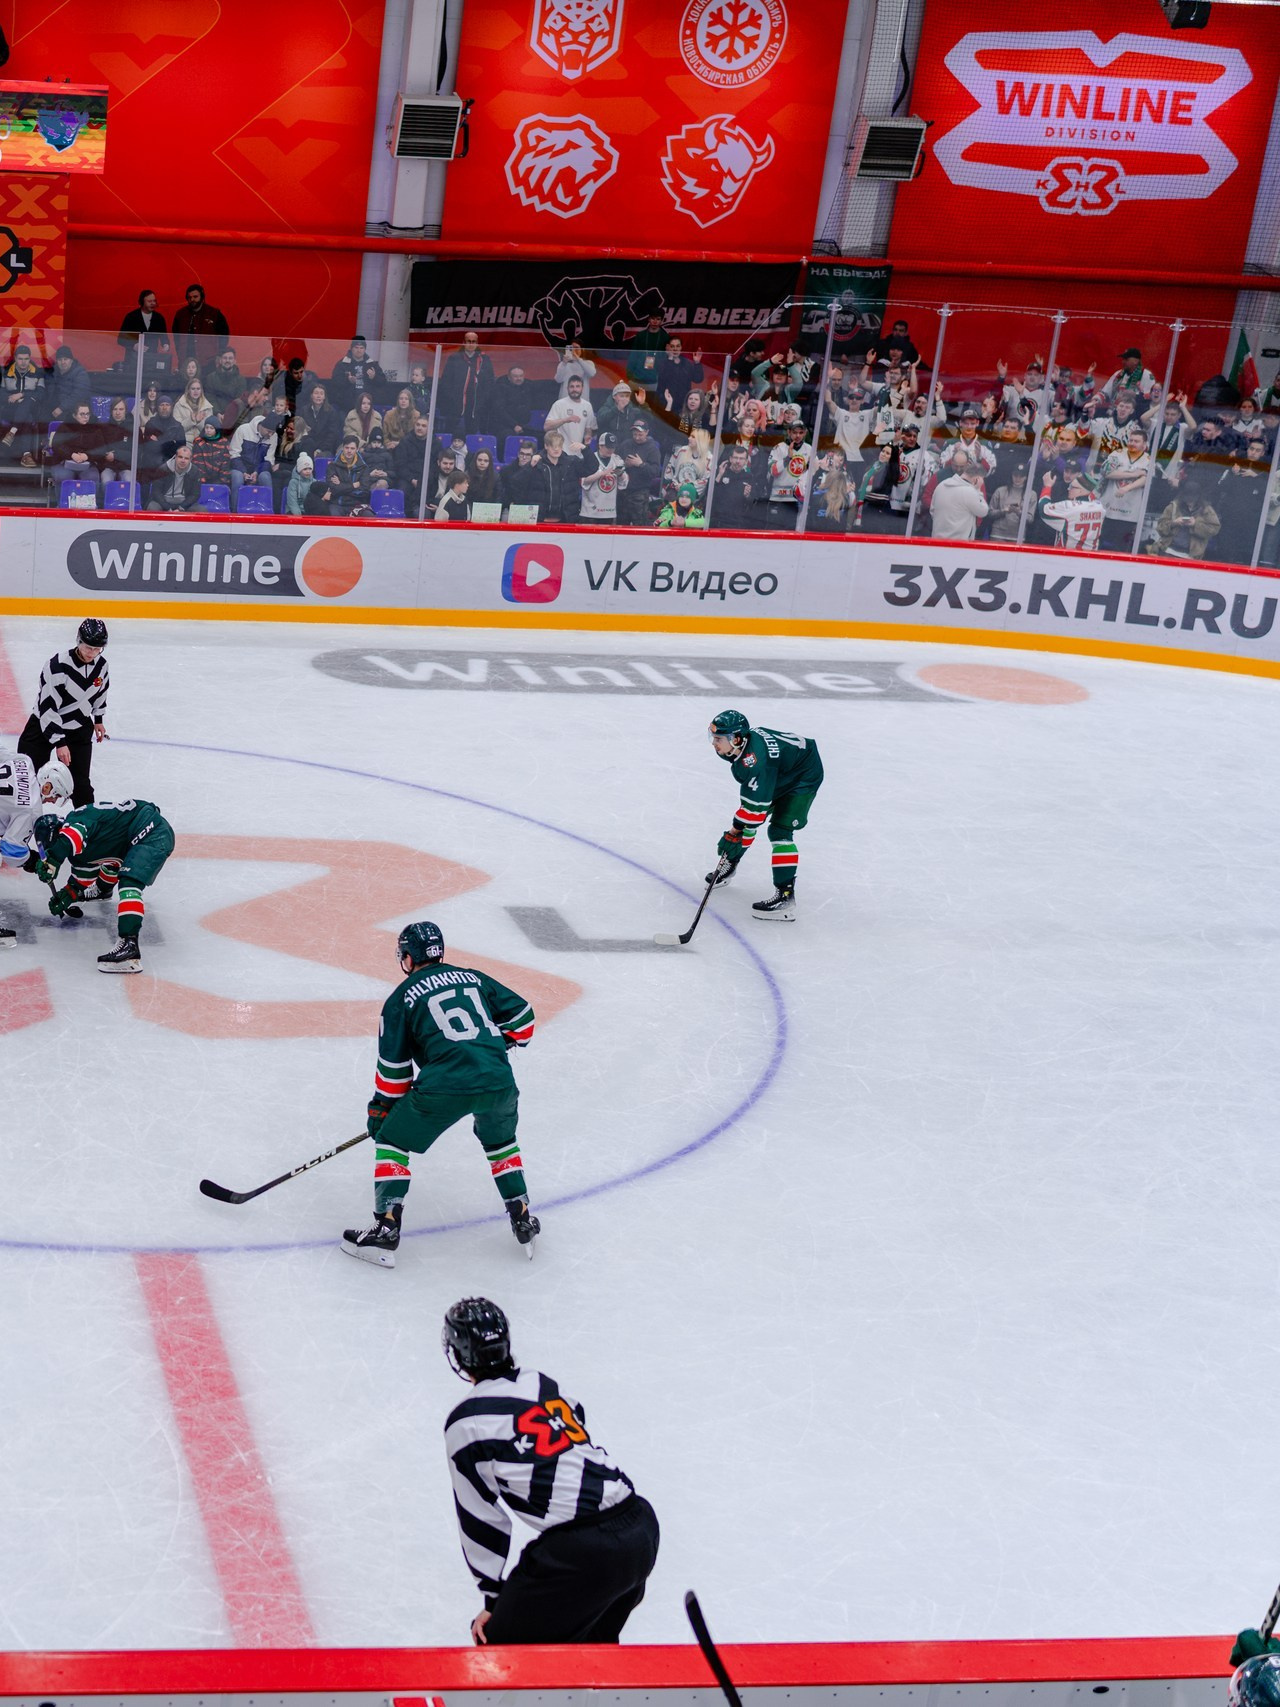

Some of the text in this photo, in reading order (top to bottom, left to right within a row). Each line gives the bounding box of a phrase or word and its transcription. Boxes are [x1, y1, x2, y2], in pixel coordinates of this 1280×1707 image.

[683, 38, 780, 85] НОВОСИБИРСКАЯ ОБЛАСТЬ
[995, 80, 1198, 126] WINLINE
[1045, 127, 1136, 142] DIVISION
[425, 305, 535, 325] КАЗАНЦЫ
[692, 308, 786, 328] ВЫЕЗДЕ
[89, 541, 281, 585] Winline
[584, 559, 778, 600] VK Видео
[882, 563, 1278, 640] 3X3.KHL.RU
[363, 654, 884, 694] Winline
[747, 776, 760, 792] 4
[131, 821, 154, 846] CCM
[427, 987, 502, 1042] 61
[290, 1149, 337, 1177] CCM
